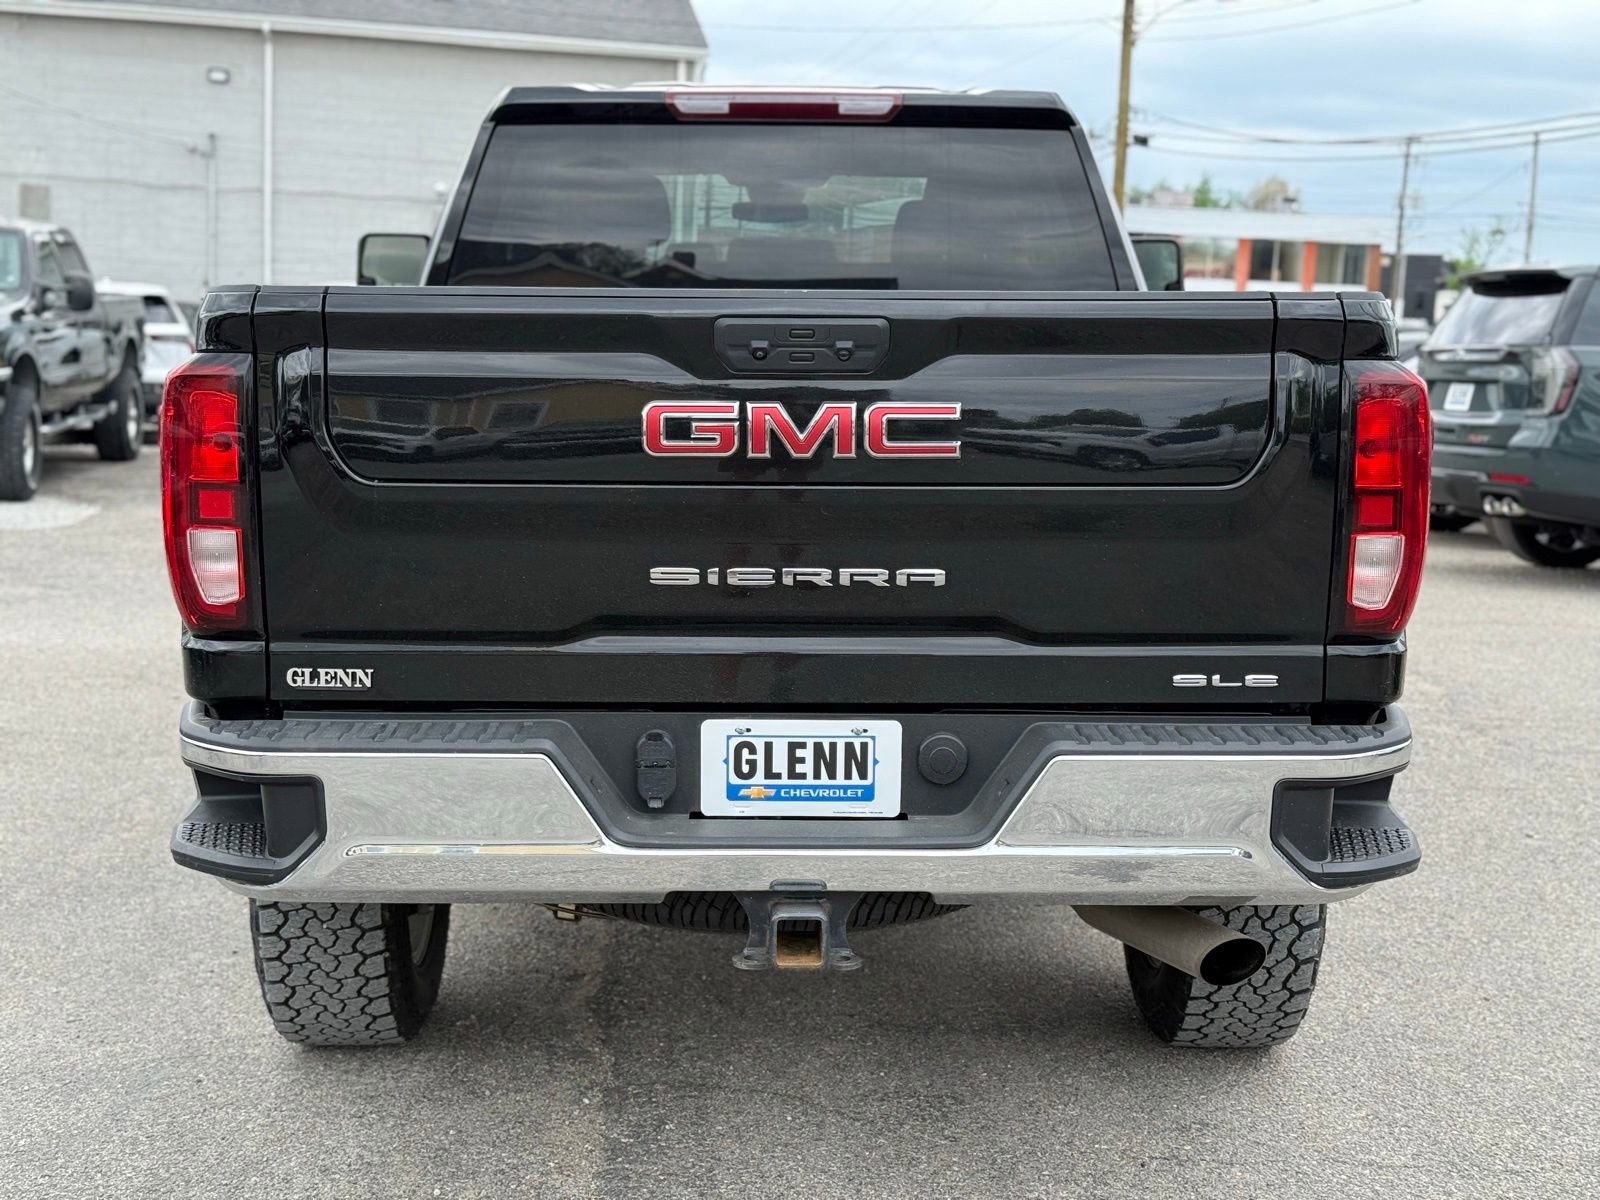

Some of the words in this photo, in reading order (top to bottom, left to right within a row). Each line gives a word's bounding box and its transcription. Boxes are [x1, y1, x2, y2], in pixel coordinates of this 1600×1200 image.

[641, 400, 962, 460] GMC
[649, 567, 947, 588] SIERRA
[286, 667, 374, 688] GLENN
[1172, 674, 1279, 688] SLE
[733, 740, 869, 781] GLENN
[780, 788, 865, 798] CHEVROLET
